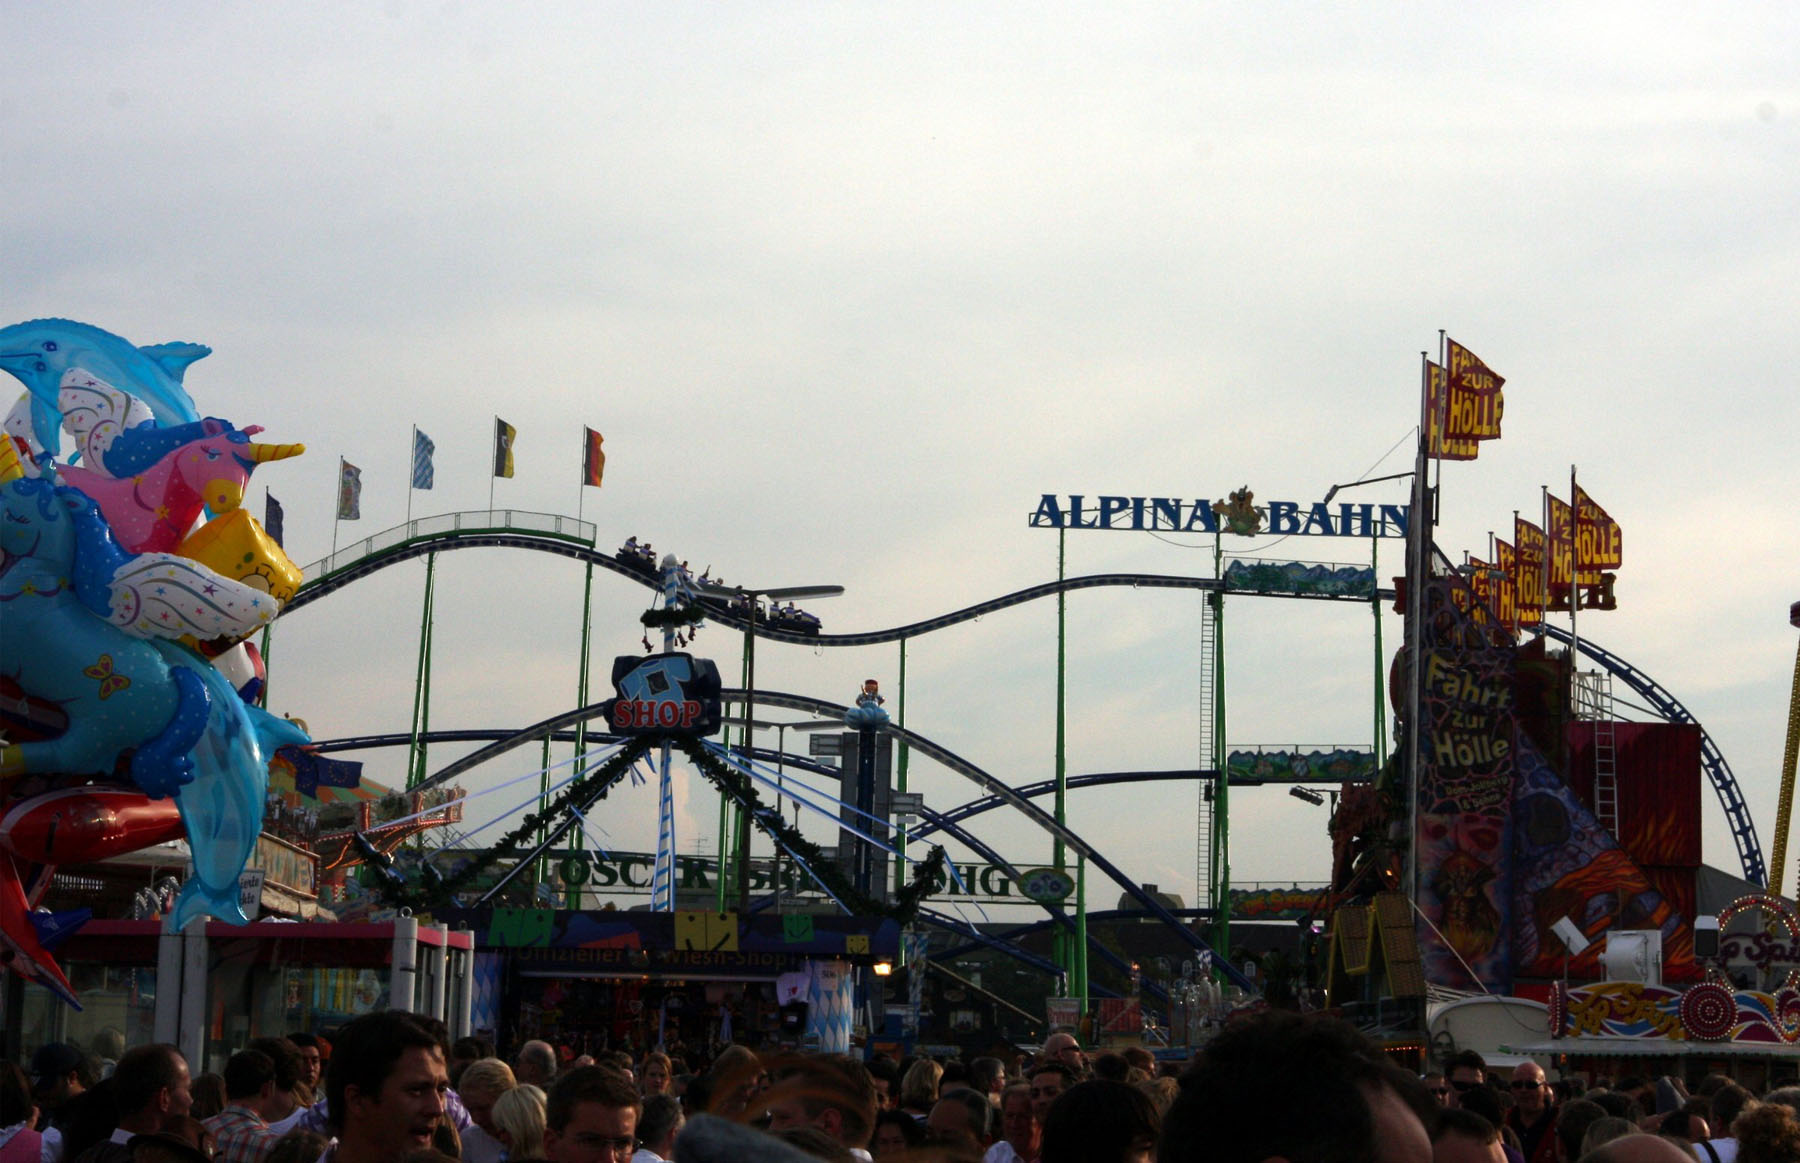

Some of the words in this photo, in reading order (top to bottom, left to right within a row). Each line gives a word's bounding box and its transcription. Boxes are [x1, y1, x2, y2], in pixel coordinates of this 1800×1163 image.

[1461, 372, 1494, 389] ZUR
[1448, 385, 1503, 436] HÖLLE
[1031, 494, 1218, 533] ALPINA
[1268, 501, 1410, 538] BAHN
[1424, 653, 1512, 709] Fahrt
[613, 700, 701, 728] SHOP
[1452, 709, 1488, 729] zur
[1432, 730, 1510, 768] Hölle
